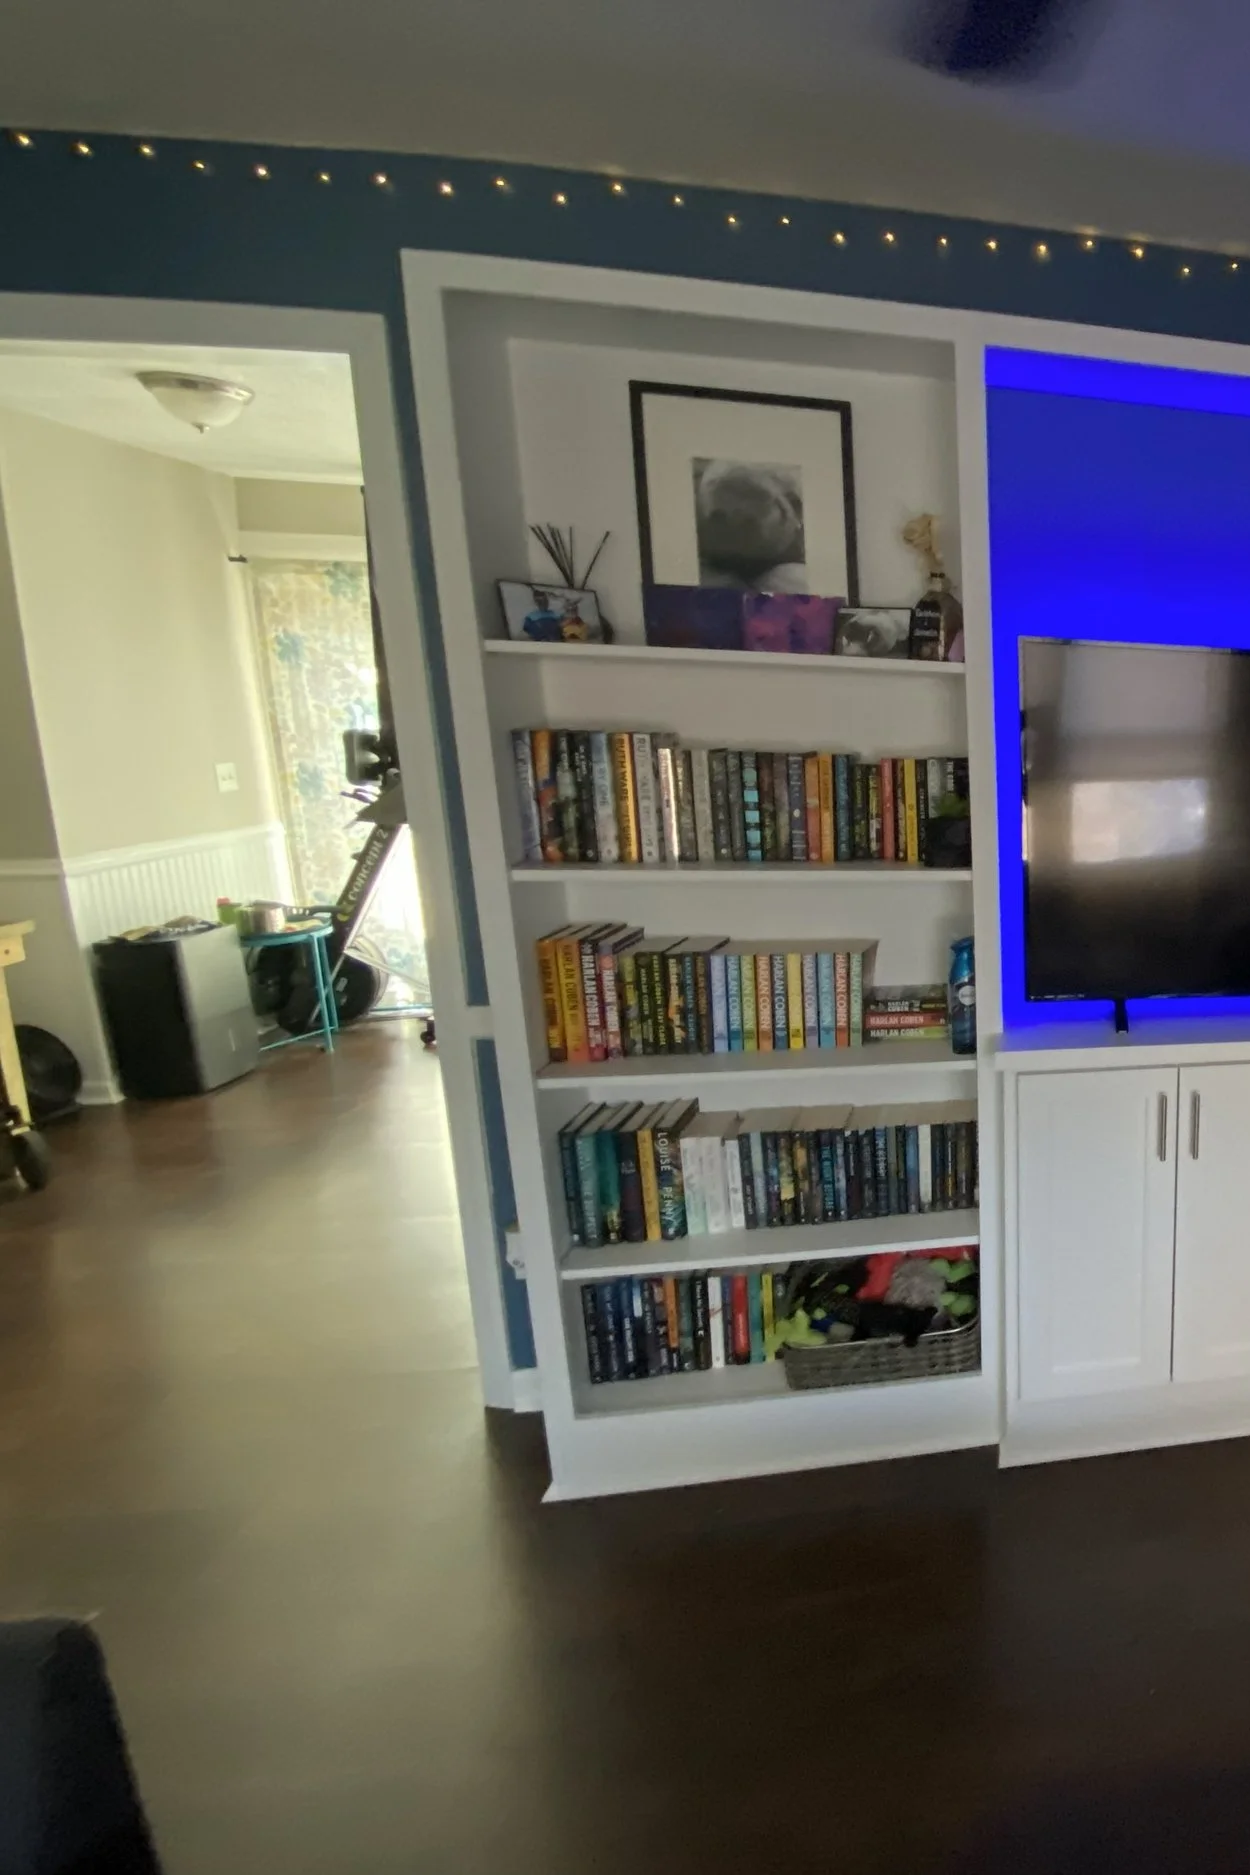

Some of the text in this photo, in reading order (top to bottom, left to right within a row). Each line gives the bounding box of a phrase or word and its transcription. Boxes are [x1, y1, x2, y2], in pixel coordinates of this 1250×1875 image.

[581, 955, 595, 993] HARLAN
[601, 968, 617, 1003] HARLAN
[804, 954, 815, 993] HARLAN
[851, 954, 862, 990] HARLAN
[758, 956, 772, 1031] HARLAN COBEN
[774, 955, 787, 1029] HARLAN COBEN
[836, 954, 849, 1027] HARLAN COBEN
[585, 994, 601, 1026] COBEN
[869, 1015, 925, 1026] HARLAN COBEN
[870, 1029, 900, 1038] HARLAN
[821, 1145, 831, 1159] THE
[657, 1132, 676, 1222] LOUISE PENNY
[822, 1160, 833, 1181] NIGHT
